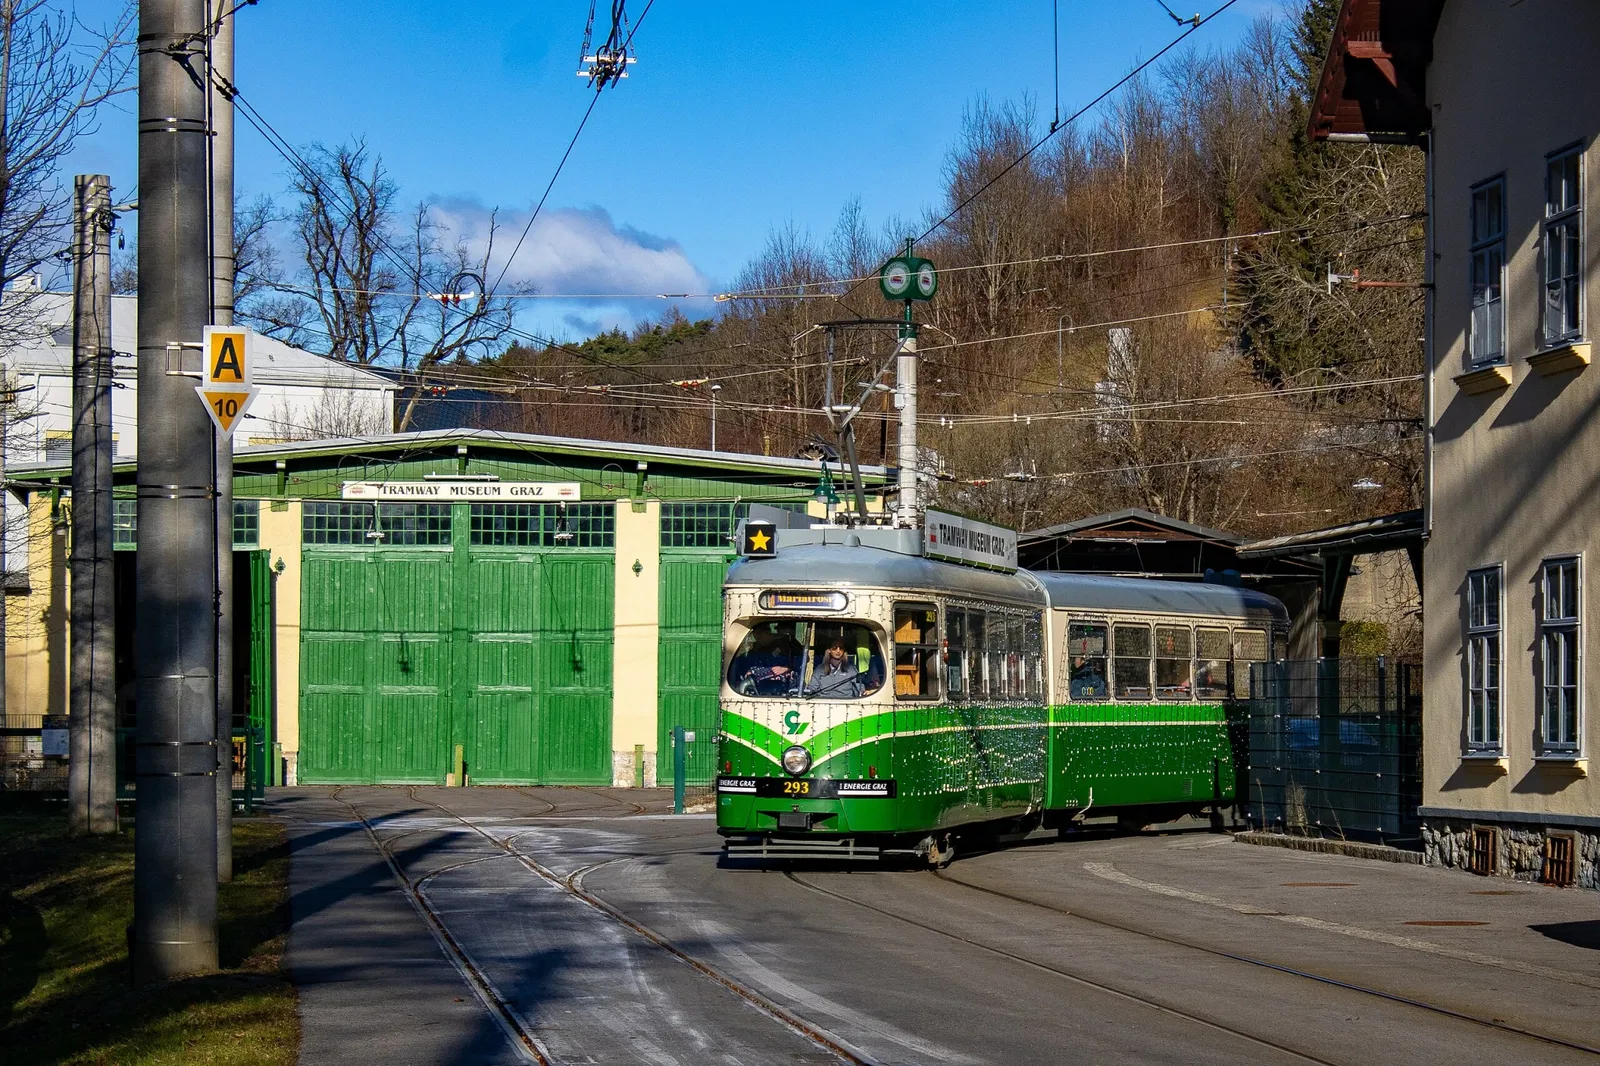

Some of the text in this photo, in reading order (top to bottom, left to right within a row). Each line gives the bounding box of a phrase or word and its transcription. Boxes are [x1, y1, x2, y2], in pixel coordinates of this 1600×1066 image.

[212, 337, 243, 379] A
[214, 398, 238, 418] 10
[382, 485, 544, 496] TRAMWAY MUSEUM GRAZ
[939, 523, 969, 549] TRAMWAY
[968, 529, 991, 555] MUSEUM
[991, 535, 1005, 557] GRAZ
[784, 781, 809, 794] 293
